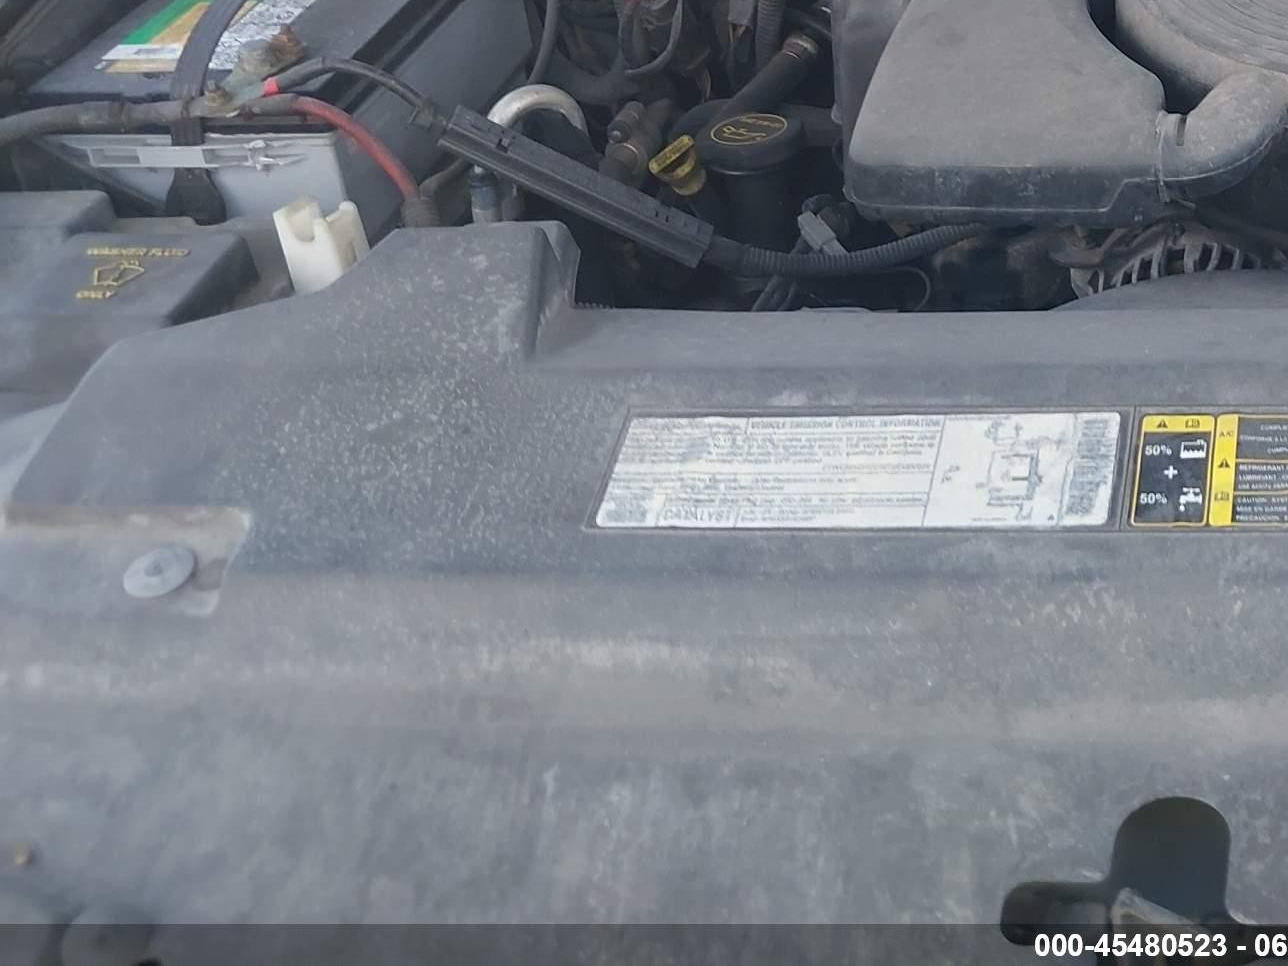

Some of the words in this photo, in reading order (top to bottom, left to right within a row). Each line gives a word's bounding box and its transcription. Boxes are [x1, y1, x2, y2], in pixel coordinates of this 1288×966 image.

[835, 419, 876, 429] CONTROL
[879, 418, 941, 428] INFORMATION
[1144, 444, 1173, 456] 50%
[1140, 492, 1168, 505] 50%
